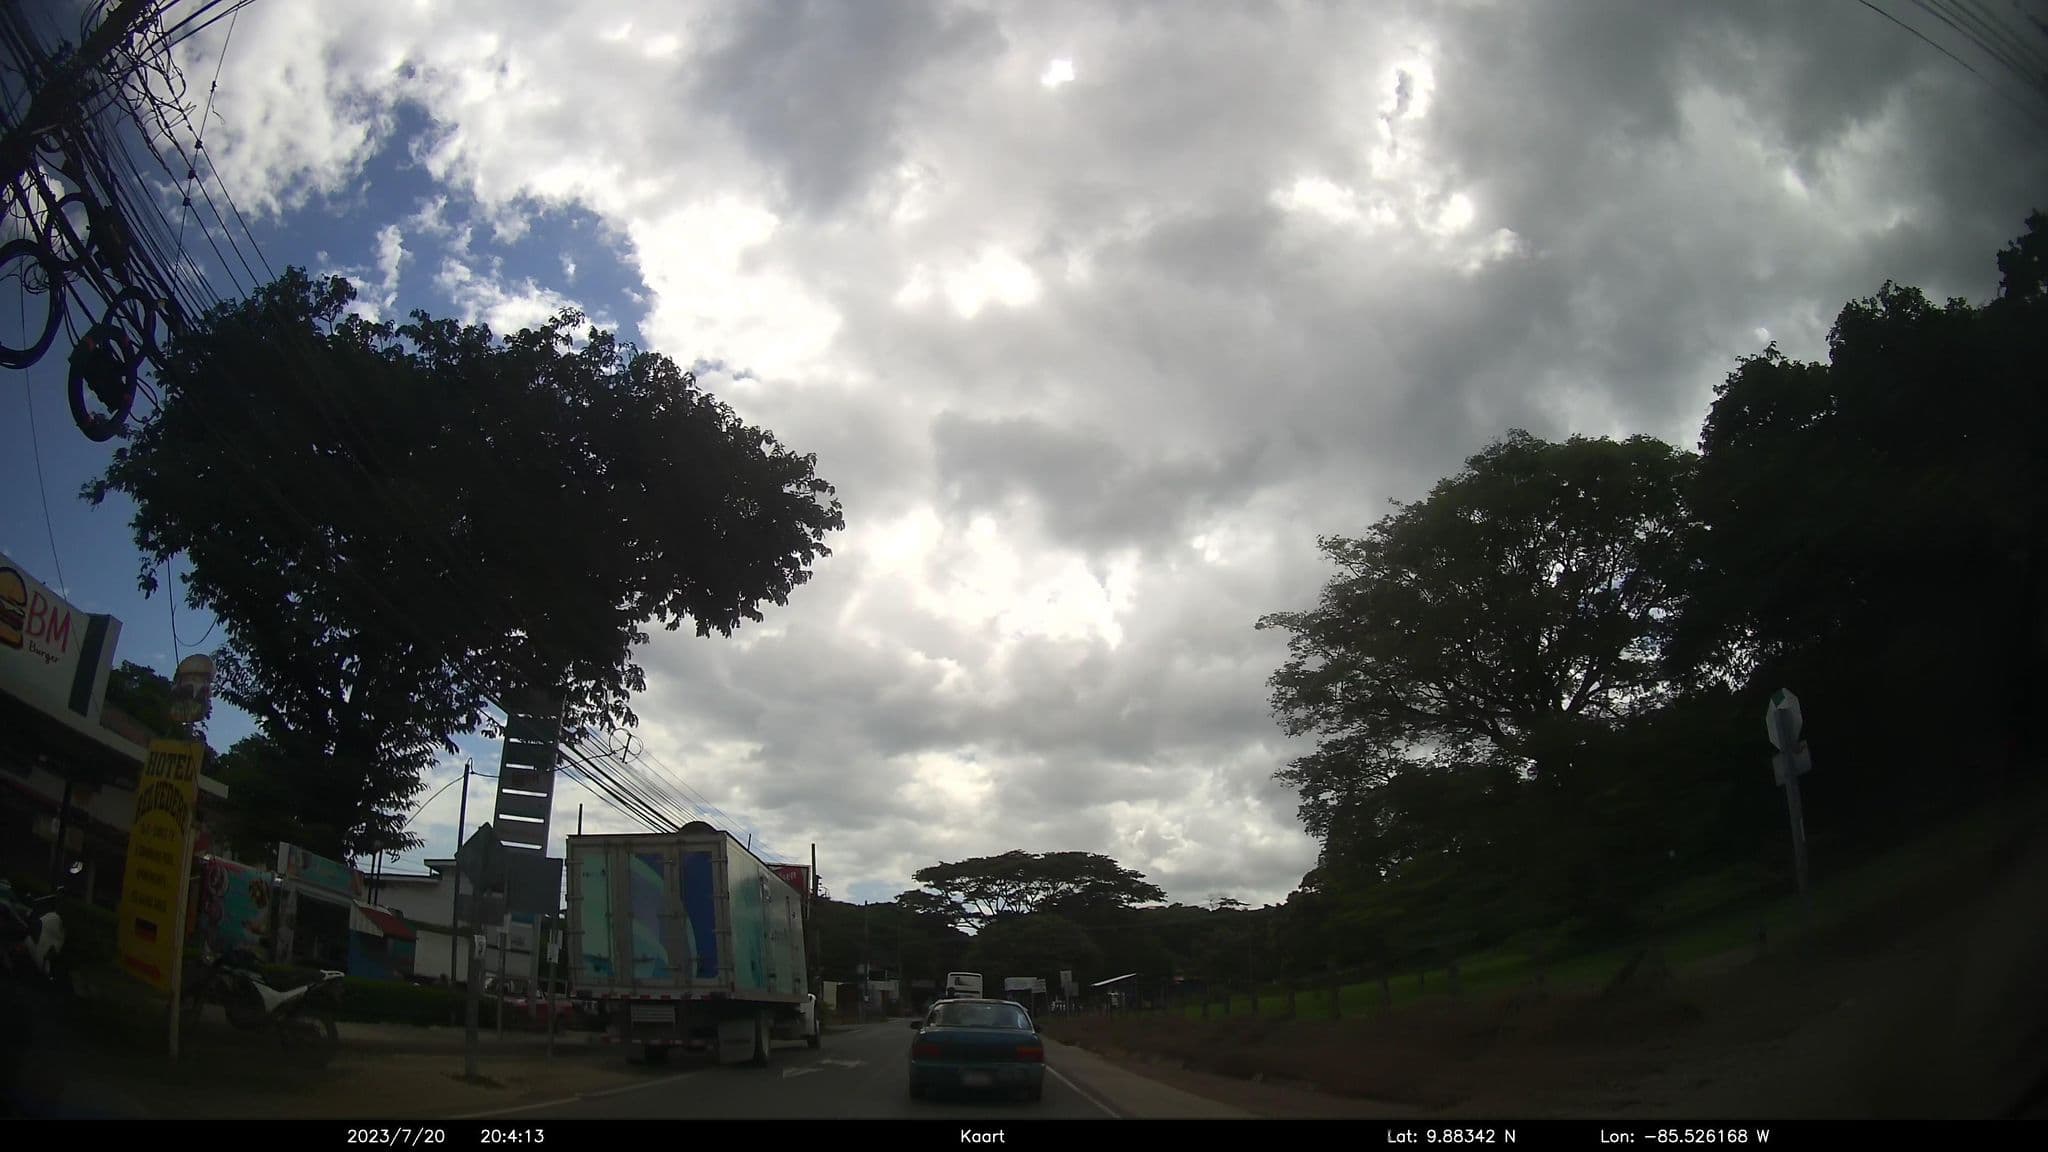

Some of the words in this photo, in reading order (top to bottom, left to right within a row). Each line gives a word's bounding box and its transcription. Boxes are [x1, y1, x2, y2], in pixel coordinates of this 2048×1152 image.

[26, 591, 71, 653] BM
[29, 640, 59, 665] Burger
[143, 751, 193, 780] HOTEL
